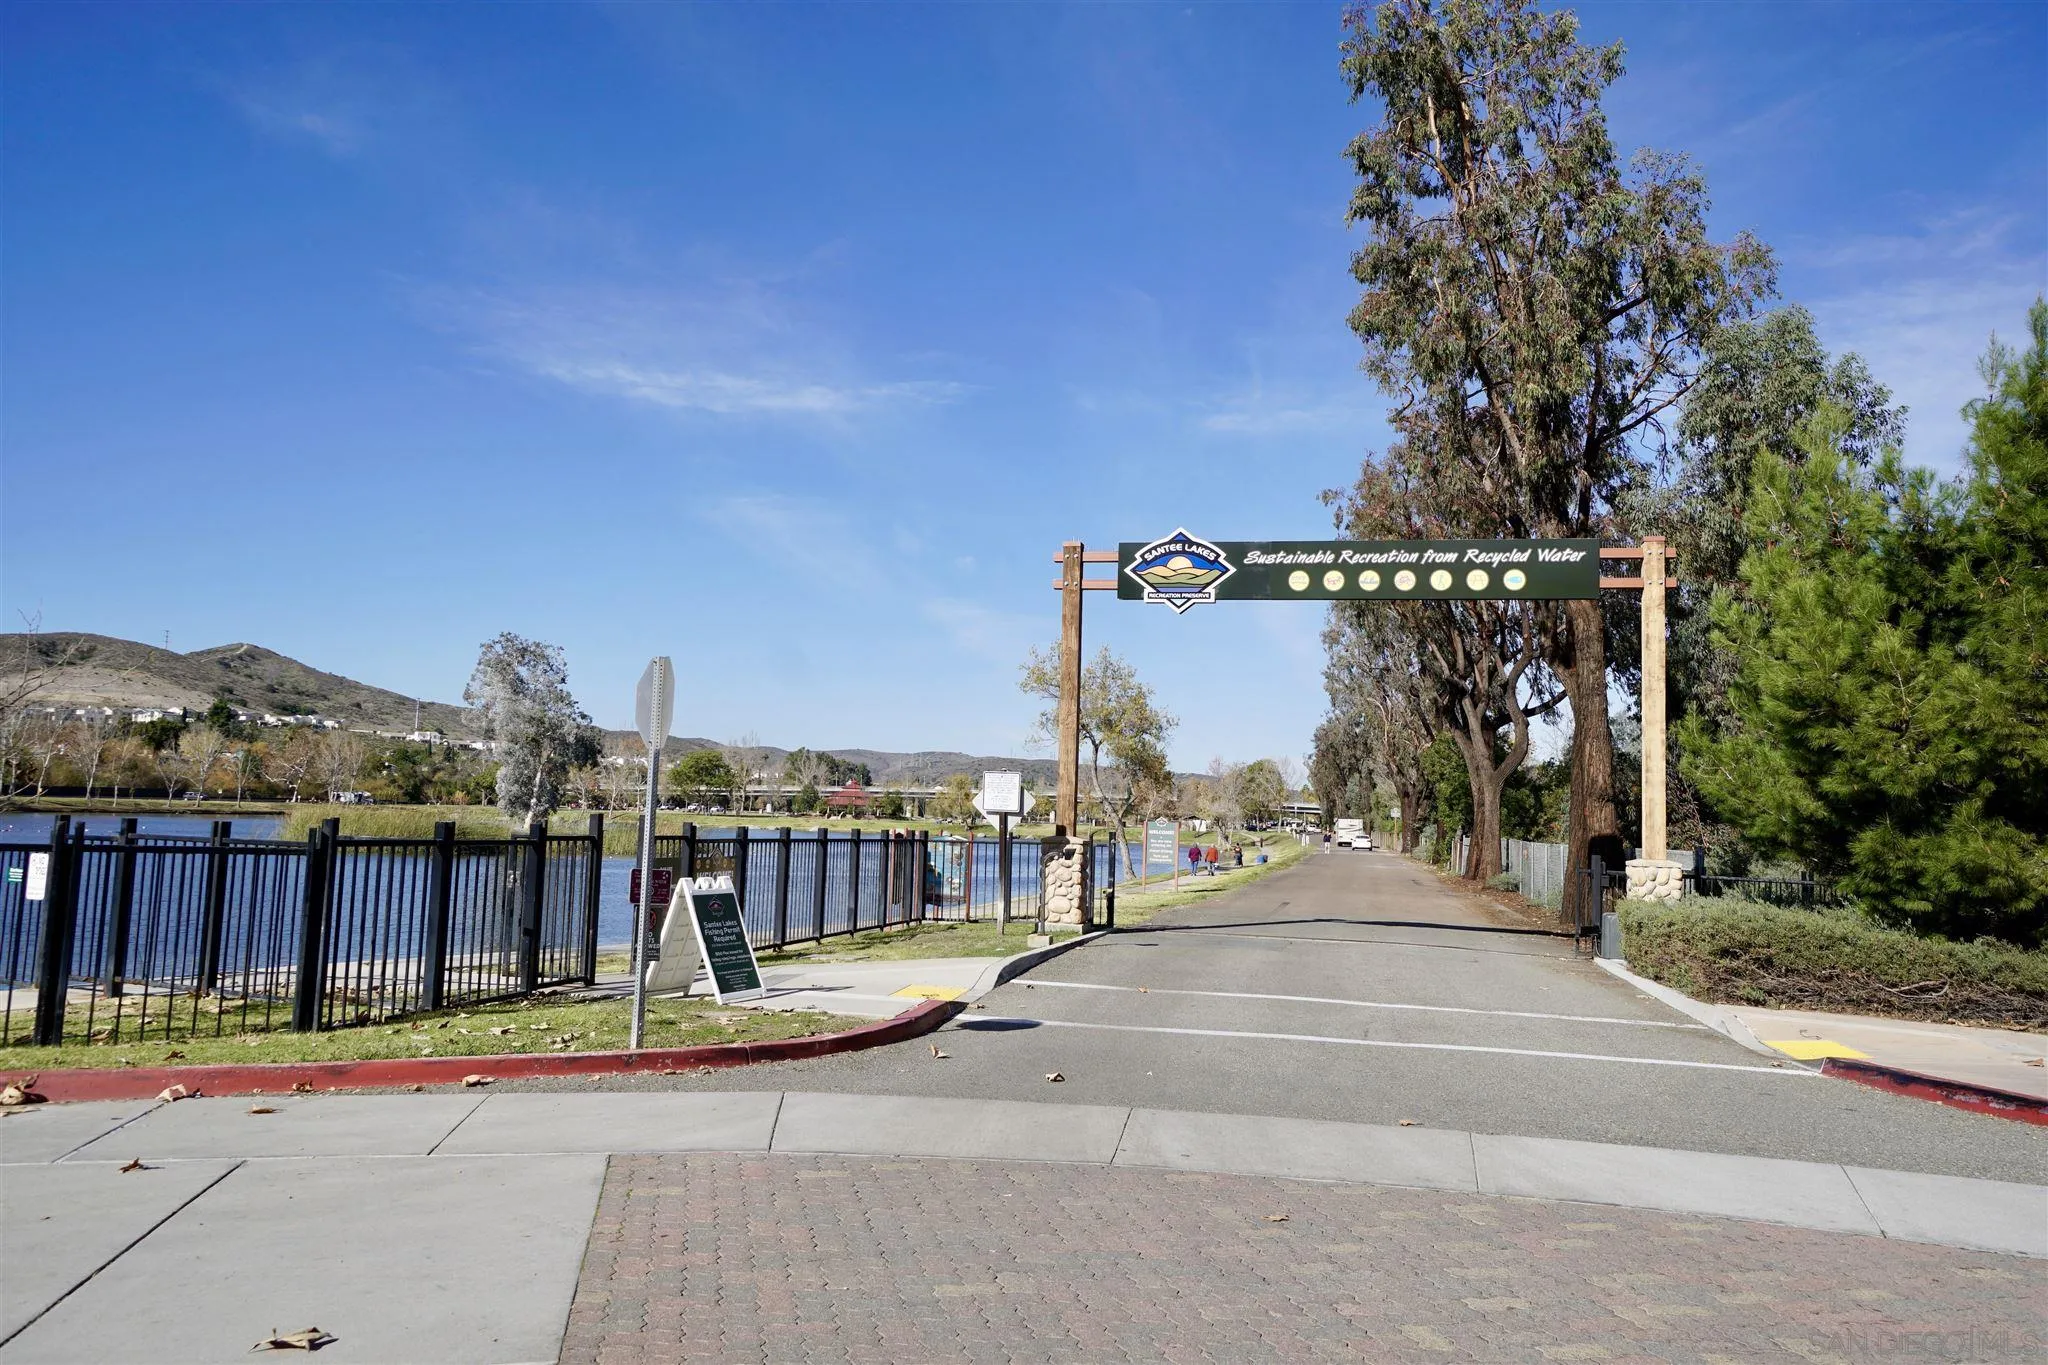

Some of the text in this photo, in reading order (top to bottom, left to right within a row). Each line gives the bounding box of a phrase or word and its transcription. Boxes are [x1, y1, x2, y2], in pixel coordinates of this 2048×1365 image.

[1144, 543, 1217, 561] SANTEE LAKES
[1243, 547, 1587, 568] Sustainable Recreation from Recycled Water
[703, 919, 738, 929] Santee Lakes
[704, 926, 741, 936] Fishing Permit
[713, 934, 737, 942] Required
